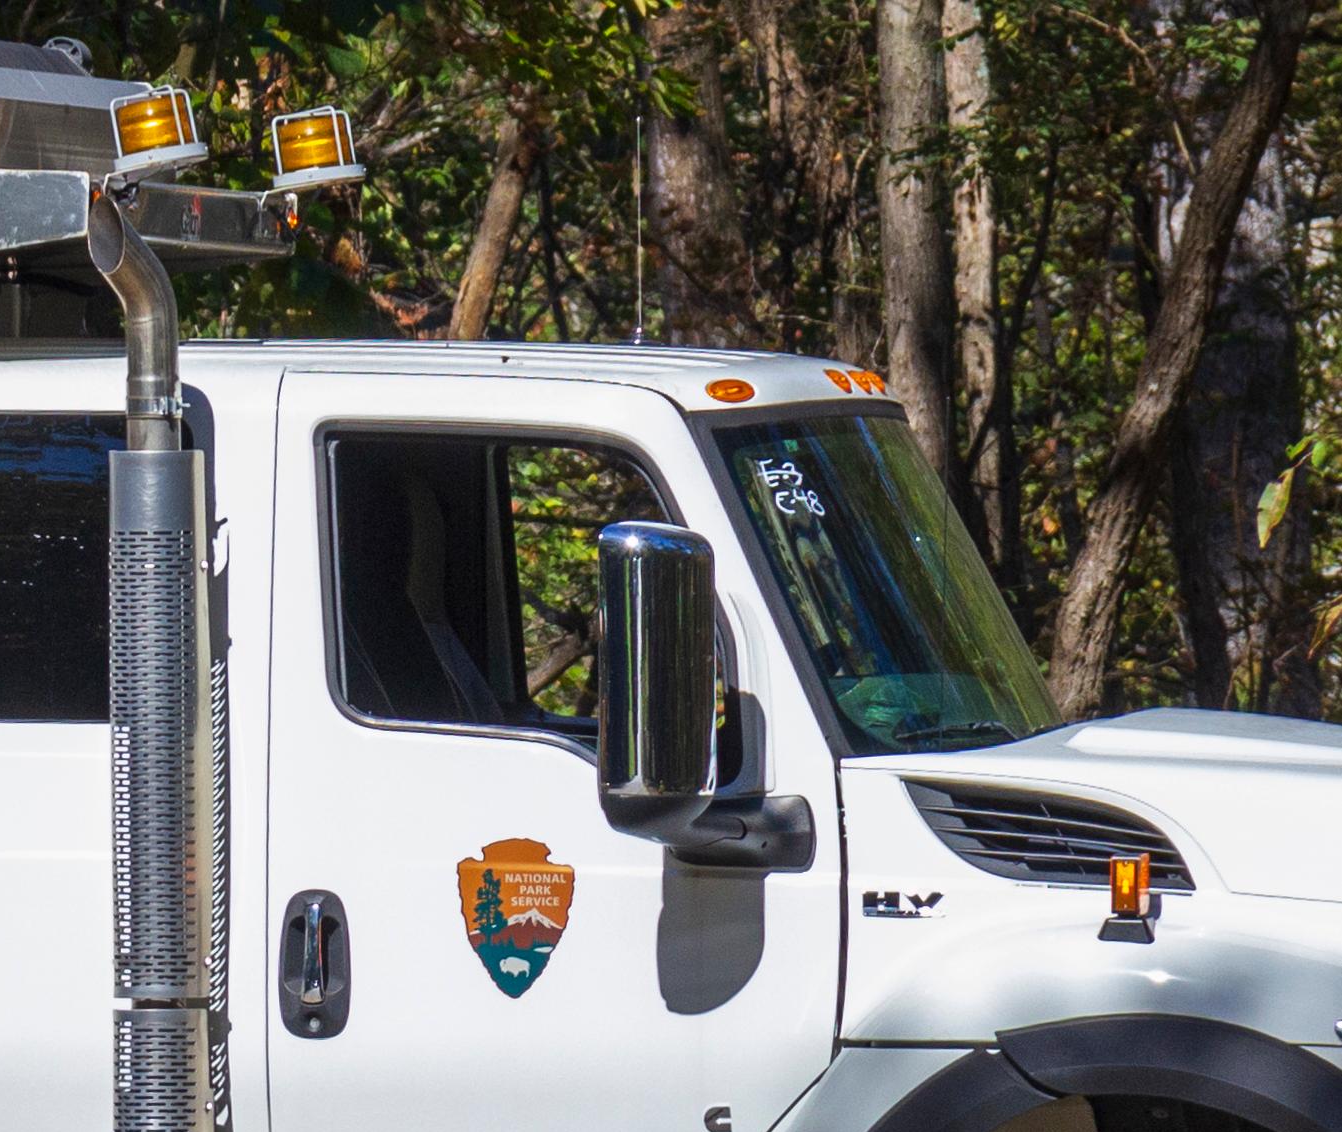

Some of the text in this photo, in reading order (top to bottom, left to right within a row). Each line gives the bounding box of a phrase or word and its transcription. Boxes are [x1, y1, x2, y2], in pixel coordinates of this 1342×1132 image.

[504, 873, 567, 884] NATIONAL
[519, 885, 551, 896] PARK
[511, 896, 560, 907] SERVICE
